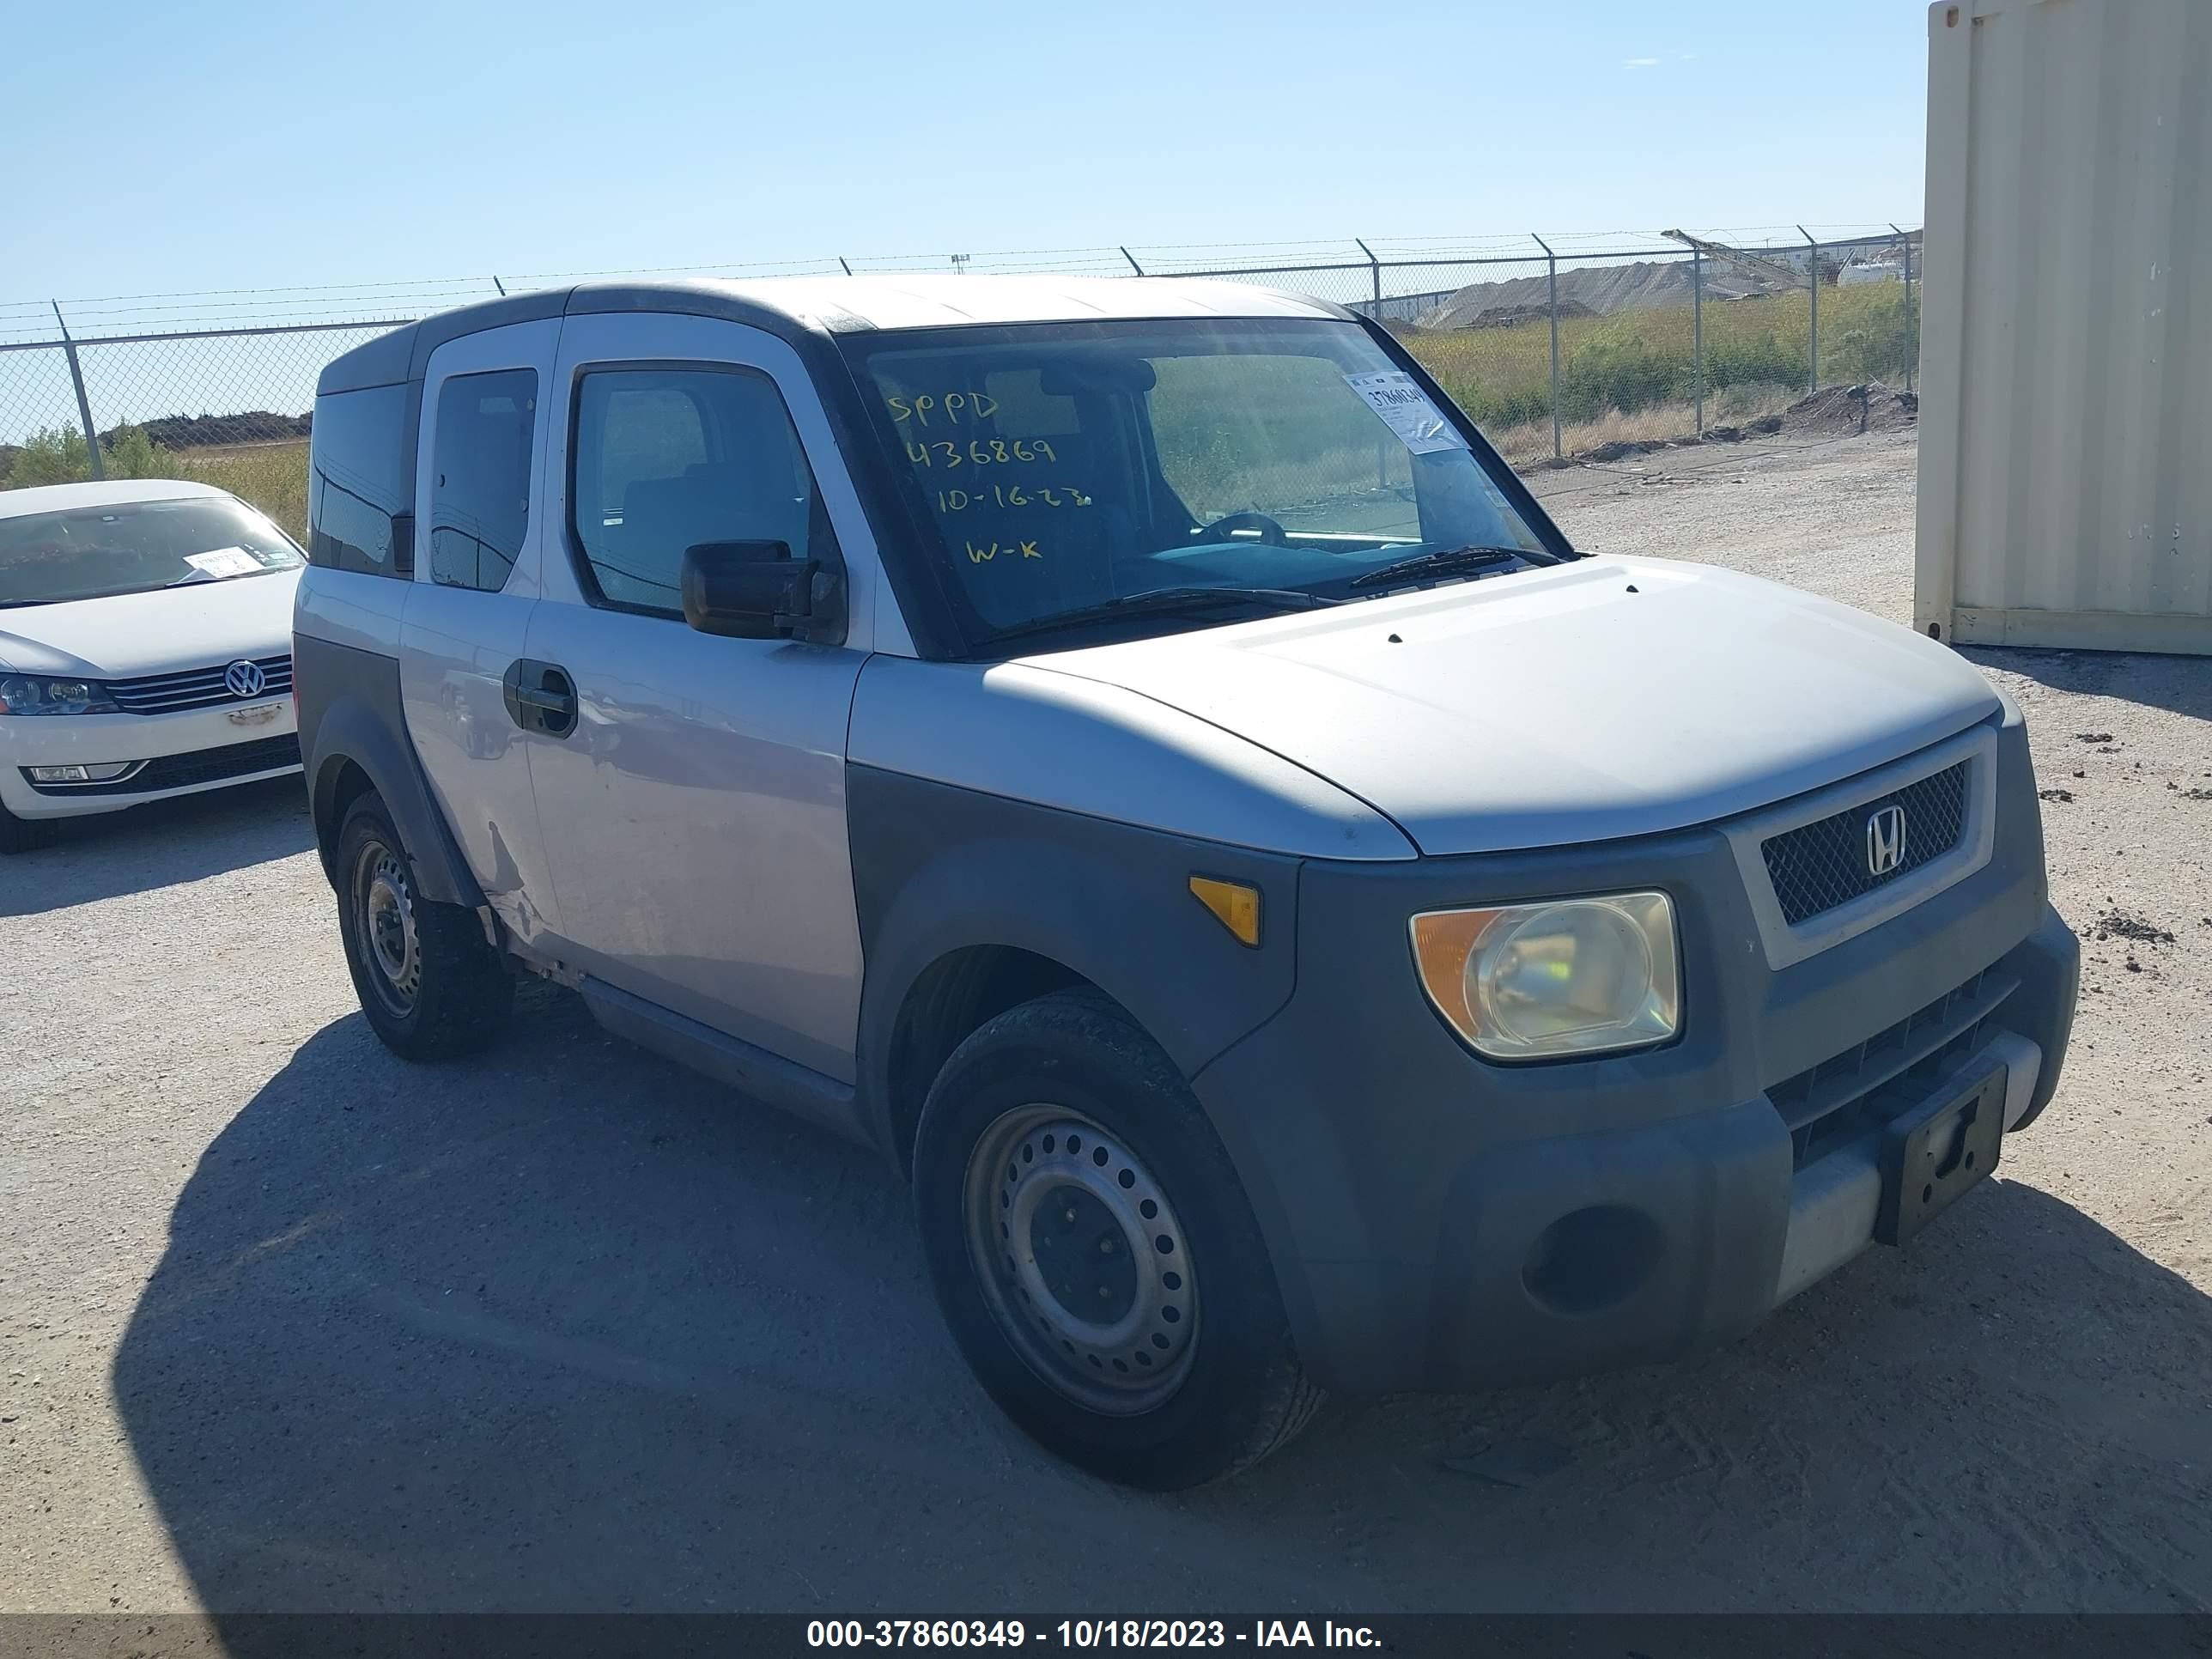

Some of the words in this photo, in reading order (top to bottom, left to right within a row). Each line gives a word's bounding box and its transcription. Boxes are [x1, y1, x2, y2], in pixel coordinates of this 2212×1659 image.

[888, 392, 1000, 427] SPPD
[1368, 388, 1425, 407] 37860349
[906, 439, 1056, 468] 436869
[226, 660, 265, 697] VW
